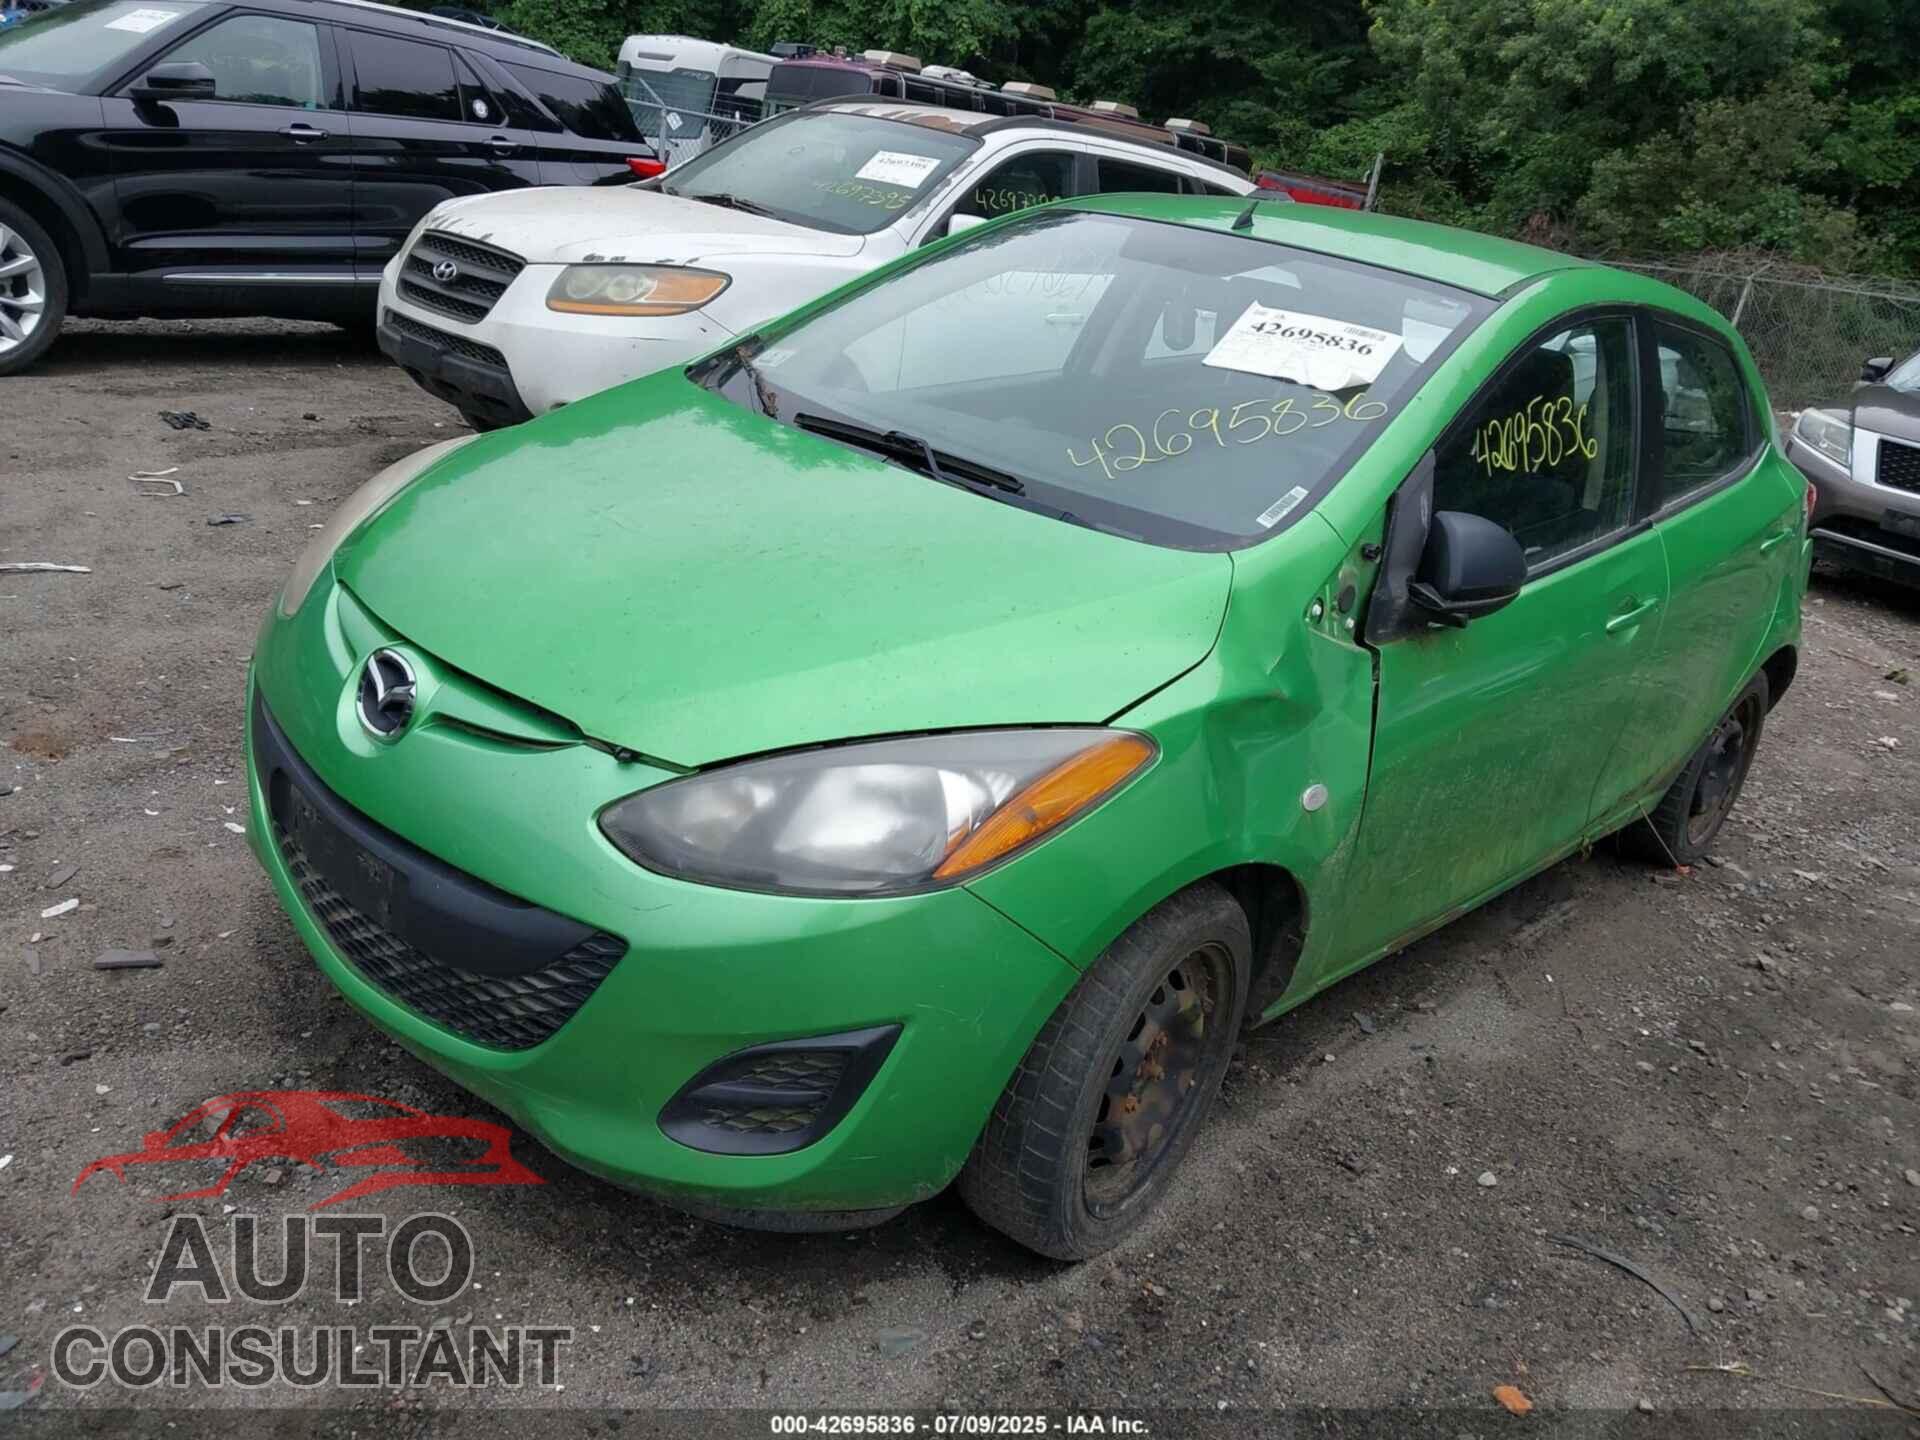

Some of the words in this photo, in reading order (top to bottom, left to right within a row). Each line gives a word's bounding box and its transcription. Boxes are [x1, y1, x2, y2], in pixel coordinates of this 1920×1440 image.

[1250, 321, 1374, 356] 42695836
[1067, 392, 1389, 480] 42695836
[1469, 395, 1598, 477] 42695836
